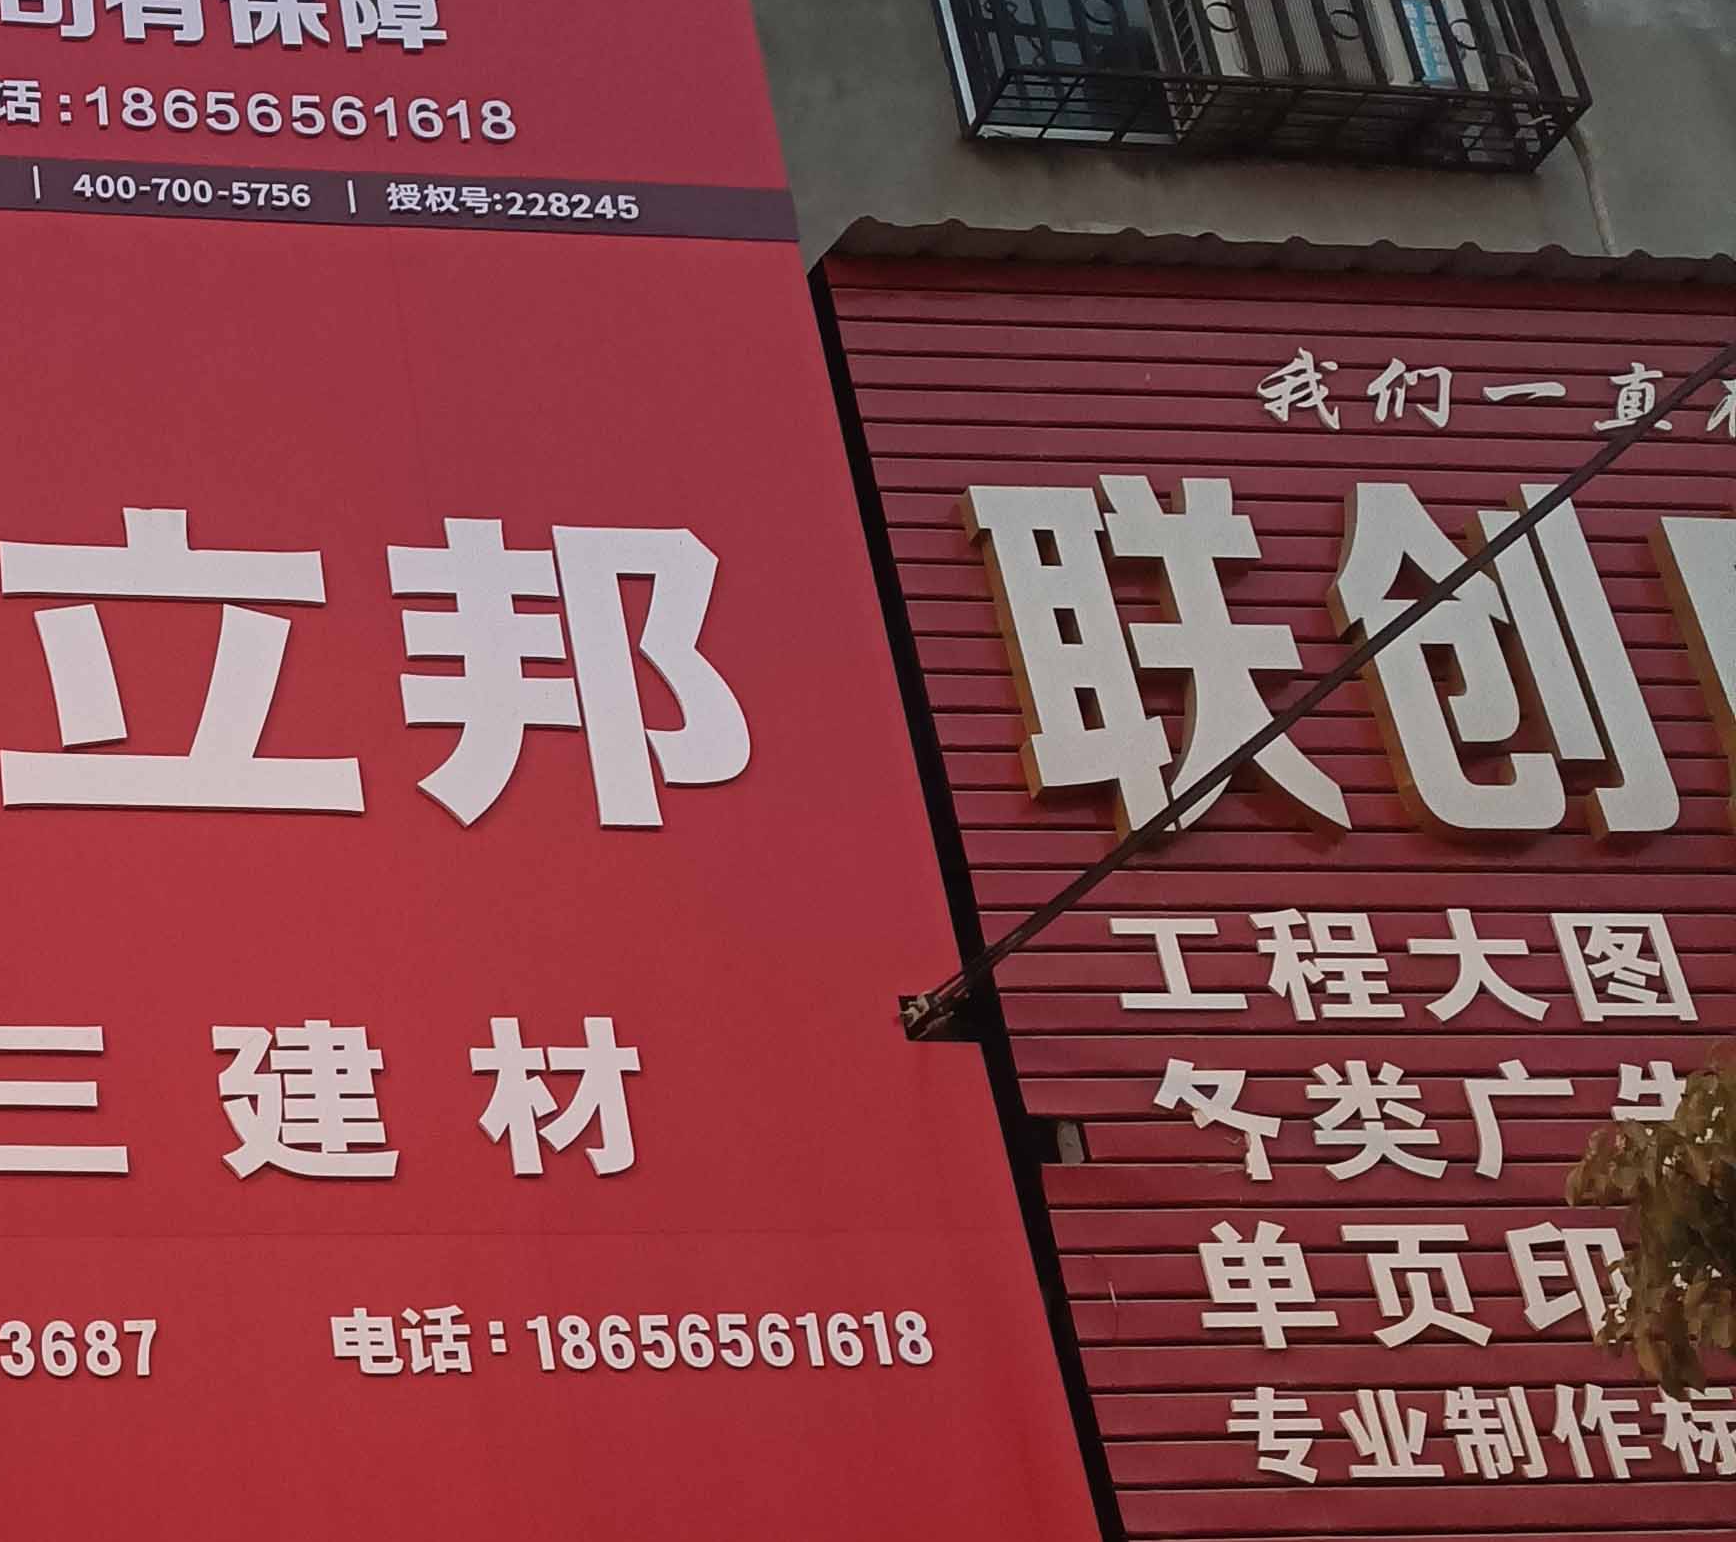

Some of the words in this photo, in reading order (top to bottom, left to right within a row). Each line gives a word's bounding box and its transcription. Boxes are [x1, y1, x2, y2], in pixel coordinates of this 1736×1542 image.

[73, 173, 312, 210] 400-700-5756
[387, 182, 641, 222] 授权号:228245
[961, 473, 1736, 844] 联创
[1109, 908, 1700, 1022] 工程大图
[328, 1306, 933, 1376] 电话:18656561618
